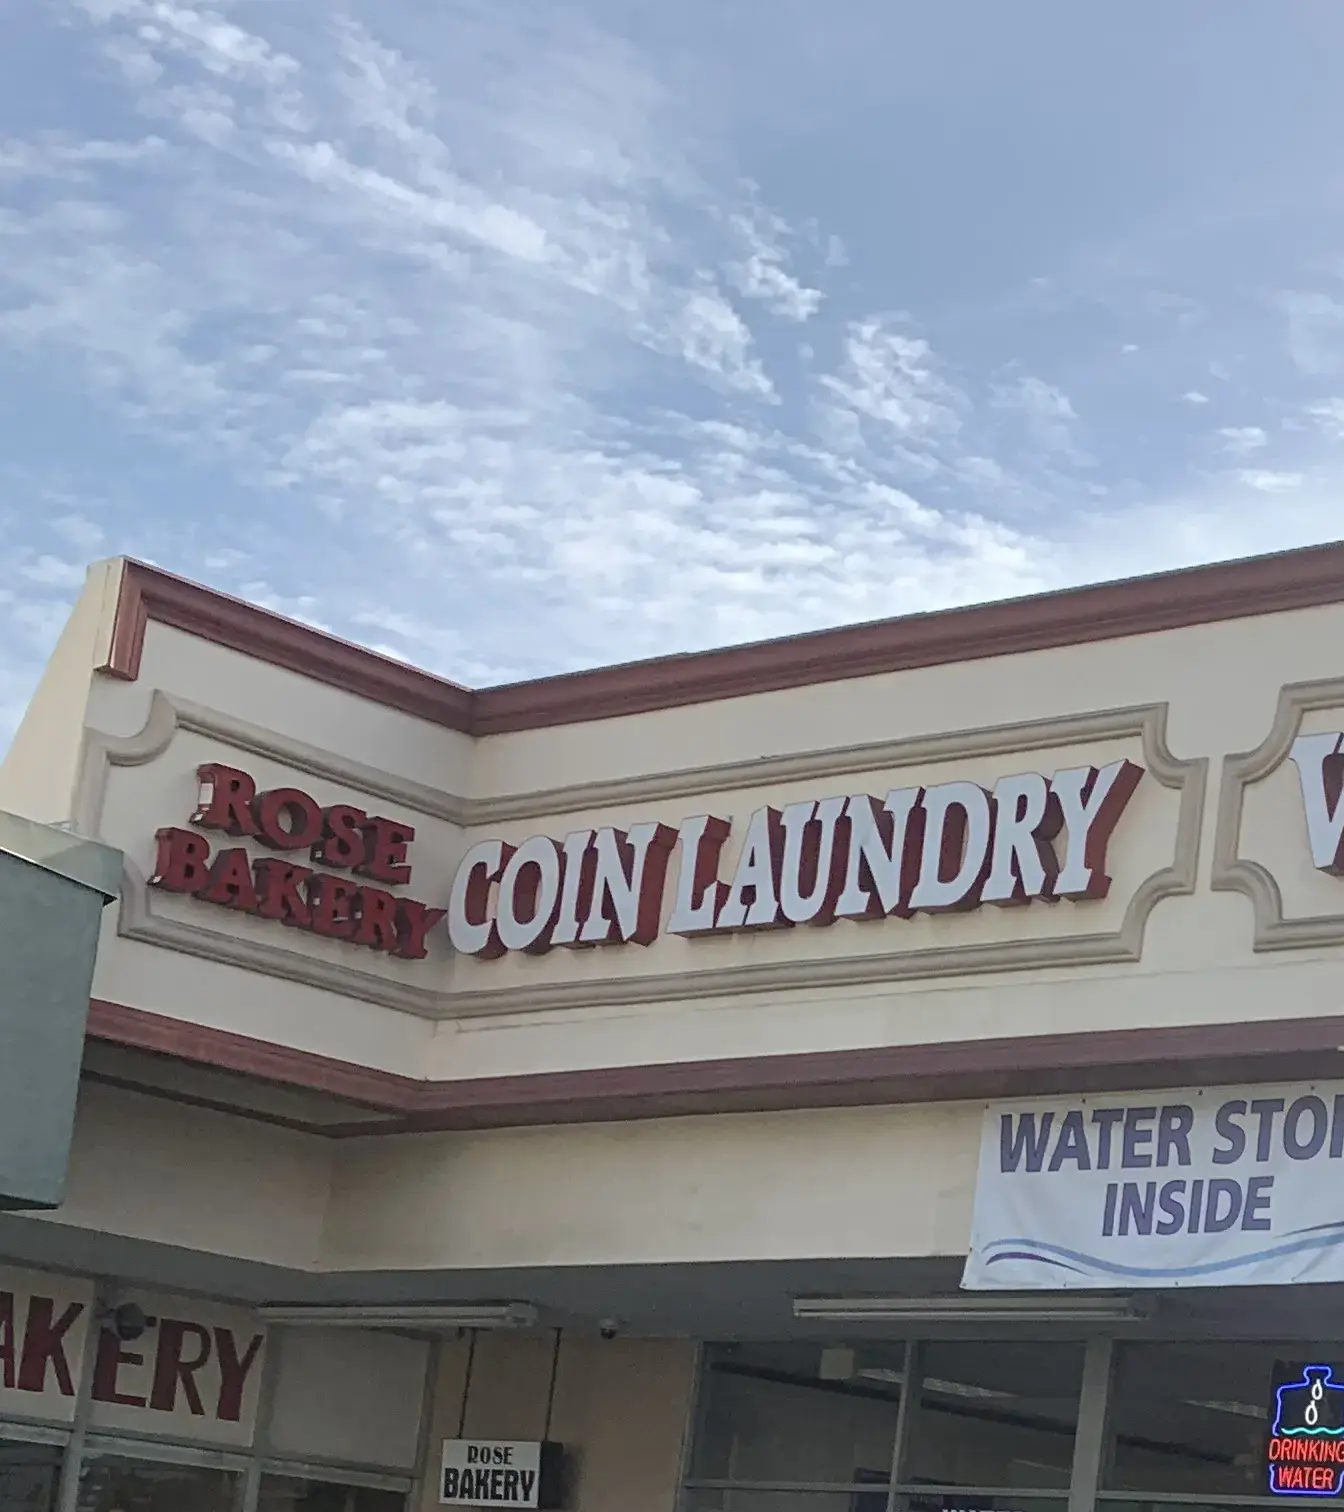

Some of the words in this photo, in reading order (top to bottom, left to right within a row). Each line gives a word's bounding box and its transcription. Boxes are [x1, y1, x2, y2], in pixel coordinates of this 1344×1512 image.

[194, 762, 415, 885] ROSE
[449, 821, 674, 957] COIN
[667, 759, 1144, 937] LAUNDRY
[149, 827, 447, 960] BAKERY
[1001, 1105, 1194, 1172] WATER
[1102, 1176, 1274, 1236] INSIDE
[444, 1468, 535, 1501] BAKERY
[468, 1446, 514, 1465] ROSE
[1279, 1466, 1334, 1489] WATER
